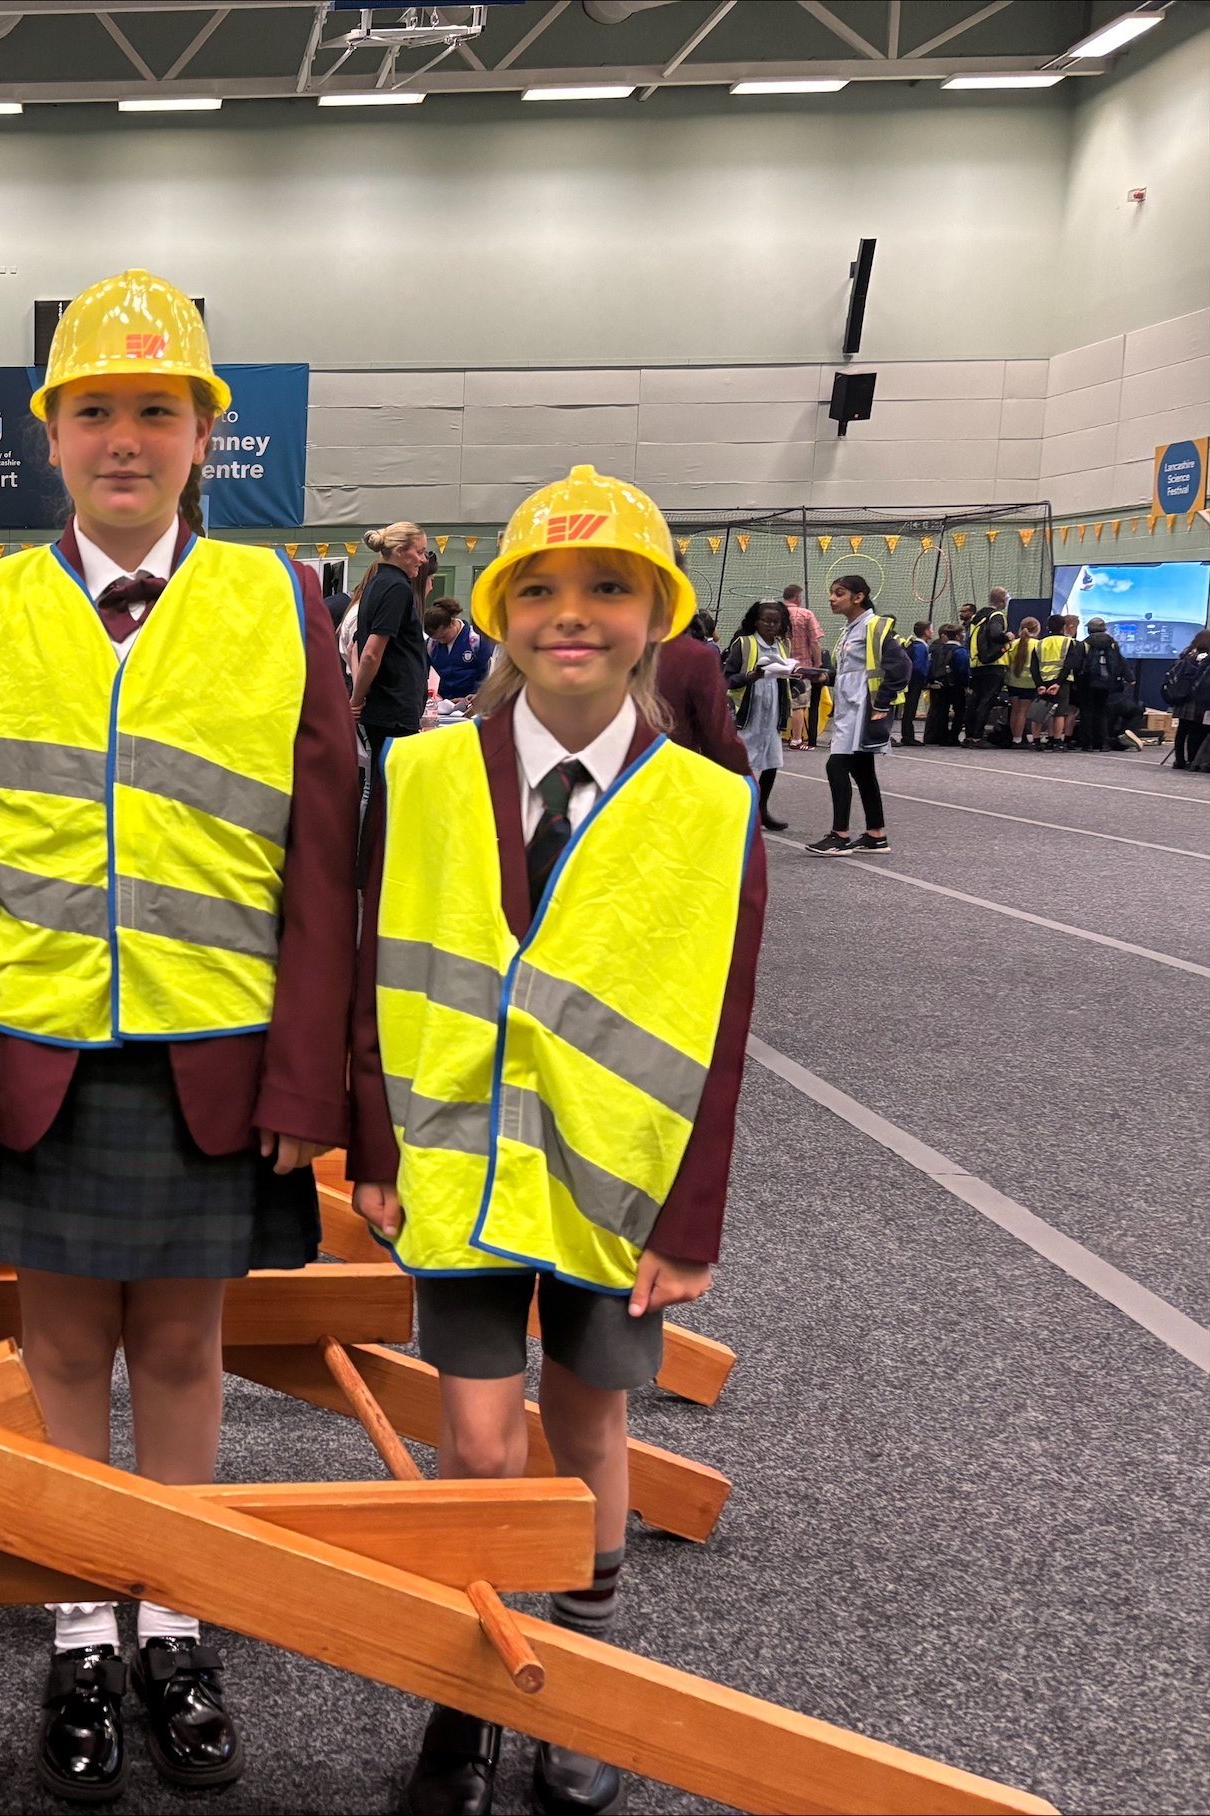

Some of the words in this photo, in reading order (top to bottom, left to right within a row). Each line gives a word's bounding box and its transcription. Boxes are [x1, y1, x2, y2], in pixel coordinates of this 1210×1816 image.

[211, 436, 270, 457] nney
[4, 451, 12, 459] of
[201, 461, 264, 479] entre
[1164, 459, 1195, 472] Lancashire
[1167, 474, 1190, 484] Science
[1167, 484, 1190, 496] Festival
